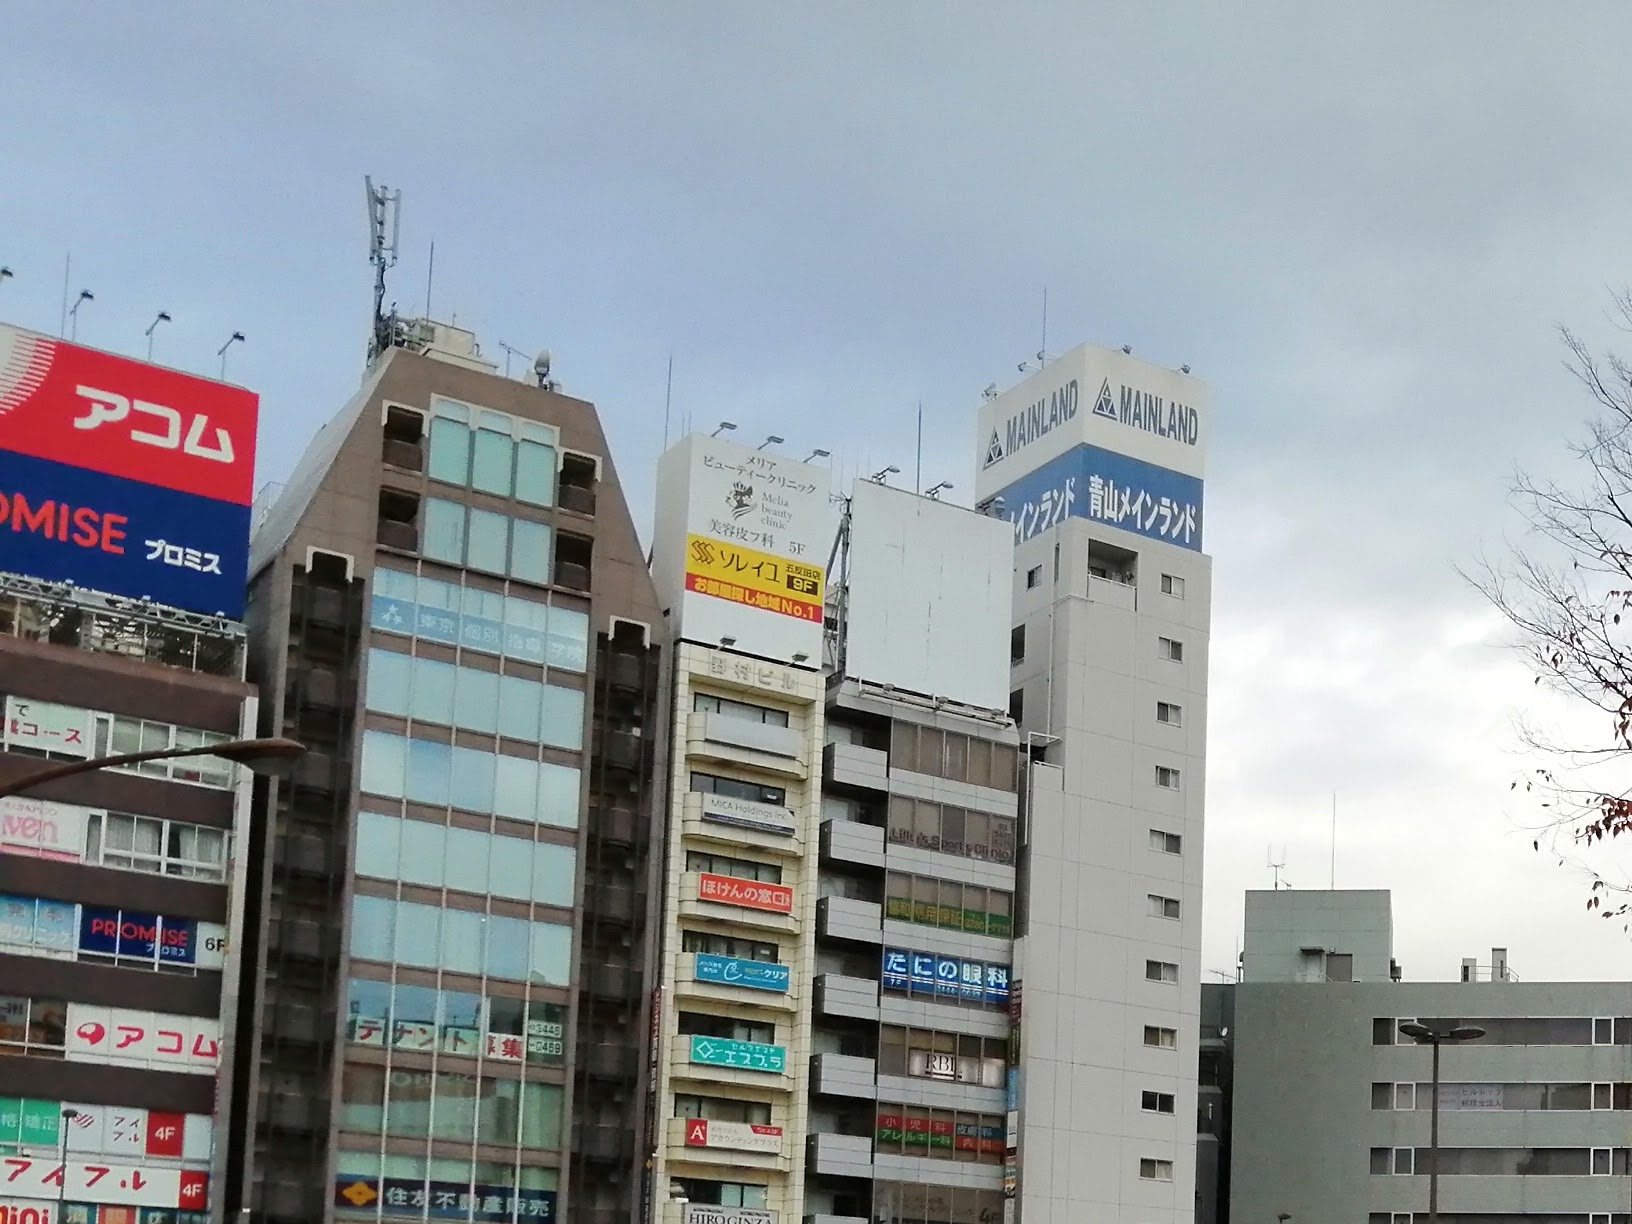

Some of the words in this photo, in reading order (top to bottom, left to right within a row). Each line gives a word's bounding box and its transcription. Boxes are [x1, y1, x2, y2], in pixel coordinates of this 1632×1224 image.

[74, 384, 234, 463] アコム
[1006, 378, 1078, 457] MAINLAND
[1119, 385, 1198, 446] MAINLAND
[703, 455, 817, 494] ビューティークリニック
[746, 455, 777, 470] メリア
[761, 504, 793, 521] beauty
[1089, 474, 1197, 543] 青山メインランド
[710, 519, 775, 549] 美容皮フ科
[789, 541, 807, 556] 5F
[145, 539, 222, 575] プロミス
[720, 551, 781, 583] ソレイユ
[786, 563, 821, 581] 五反田店
[793, 576, 813, 595] 9F
[702, 879, 784, 906] ほけんの窓口
[92, 920, 188, 947] PROMISE
[887, 952, 1008, 988] たにの眼科
[116, 1026, 218, 1058] アコム
[155, 1127, 175, 1140] 4F
[881, 1129, 951, 1146] アレルギー科
[885, 1118, 946, 1132] 小児科
[182, 1184, 203, 1198] 4F
[386, 1186, 550, 1217] 住友不動産販売
